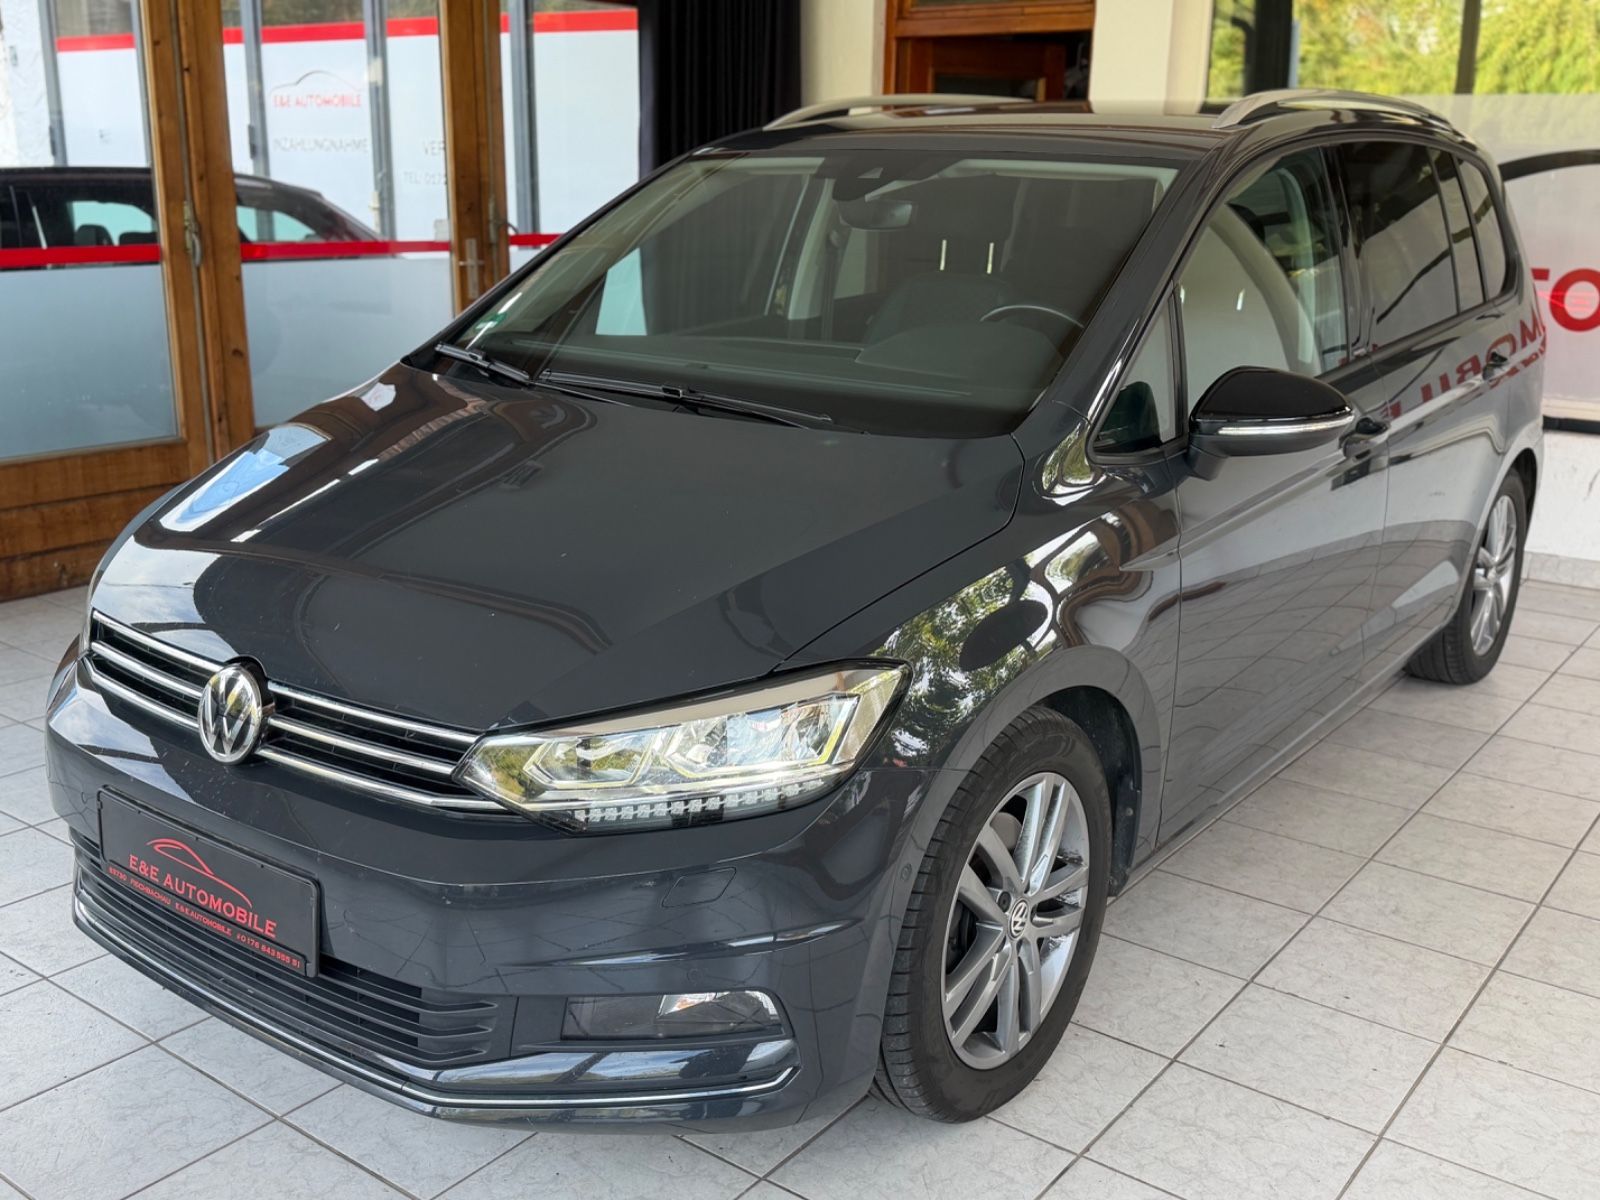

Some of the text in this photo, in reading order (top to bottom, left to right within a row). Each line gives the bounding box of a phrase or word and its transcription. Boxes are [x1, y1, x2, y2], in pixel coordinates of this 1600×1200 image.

[295, 94, 362, 108] AUTOMOBILE
[129, 854, 278, 938] E&E AUTOMOBILE
